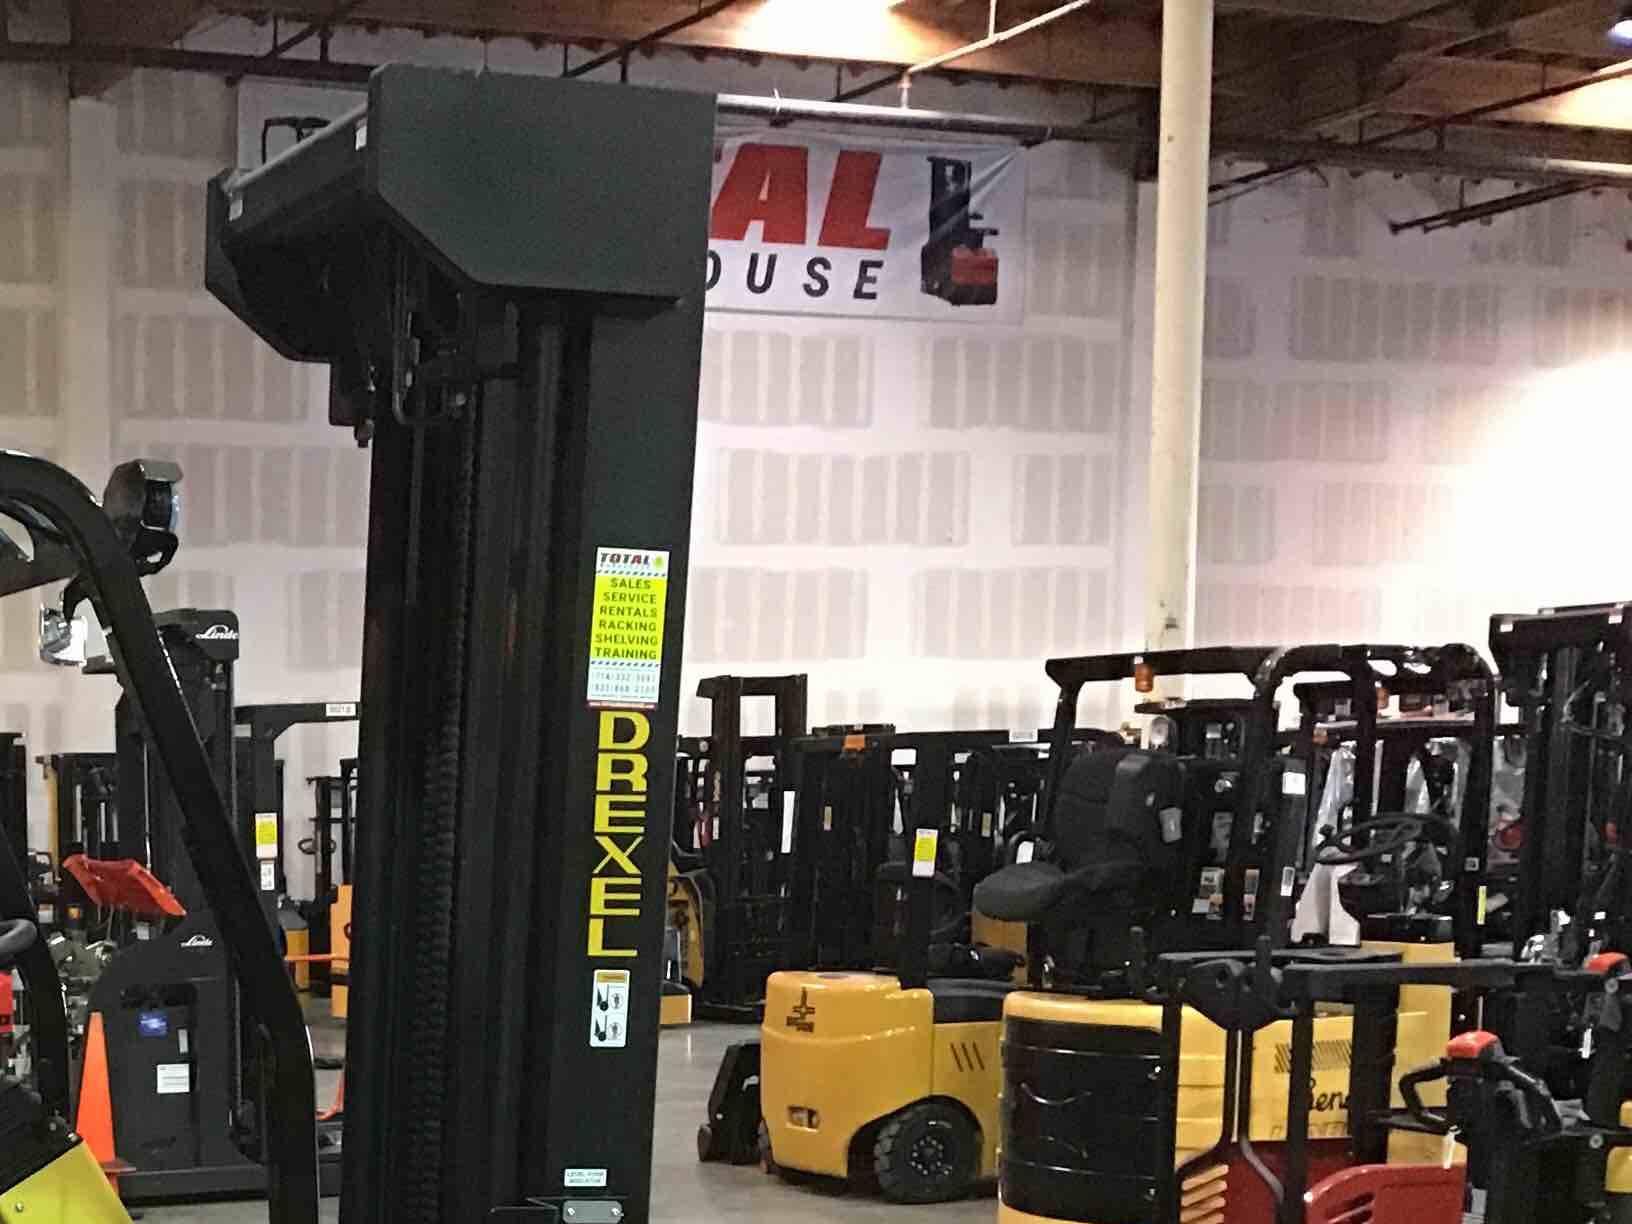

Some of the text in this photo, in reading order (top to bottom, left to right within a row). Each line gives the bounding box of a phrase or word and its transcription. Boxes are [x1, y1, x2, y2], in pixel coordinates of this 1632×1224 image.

[709, 143, 891, 250] AL
[600, 552, 649, 565] TOTAL
[610, 578, 652, 590] SALES
[603, 592, 657, 605] SERVICE
[599, 605, 658, 618] RENTALS
[599, 619, 657, 632] RACKING
[595, 633, 659, 647] SHELVING
[594, 647, 657, 660] TRAINING
[587, 710, 651, 957] DREXEL
[180, 934, 213, 948] Linde
